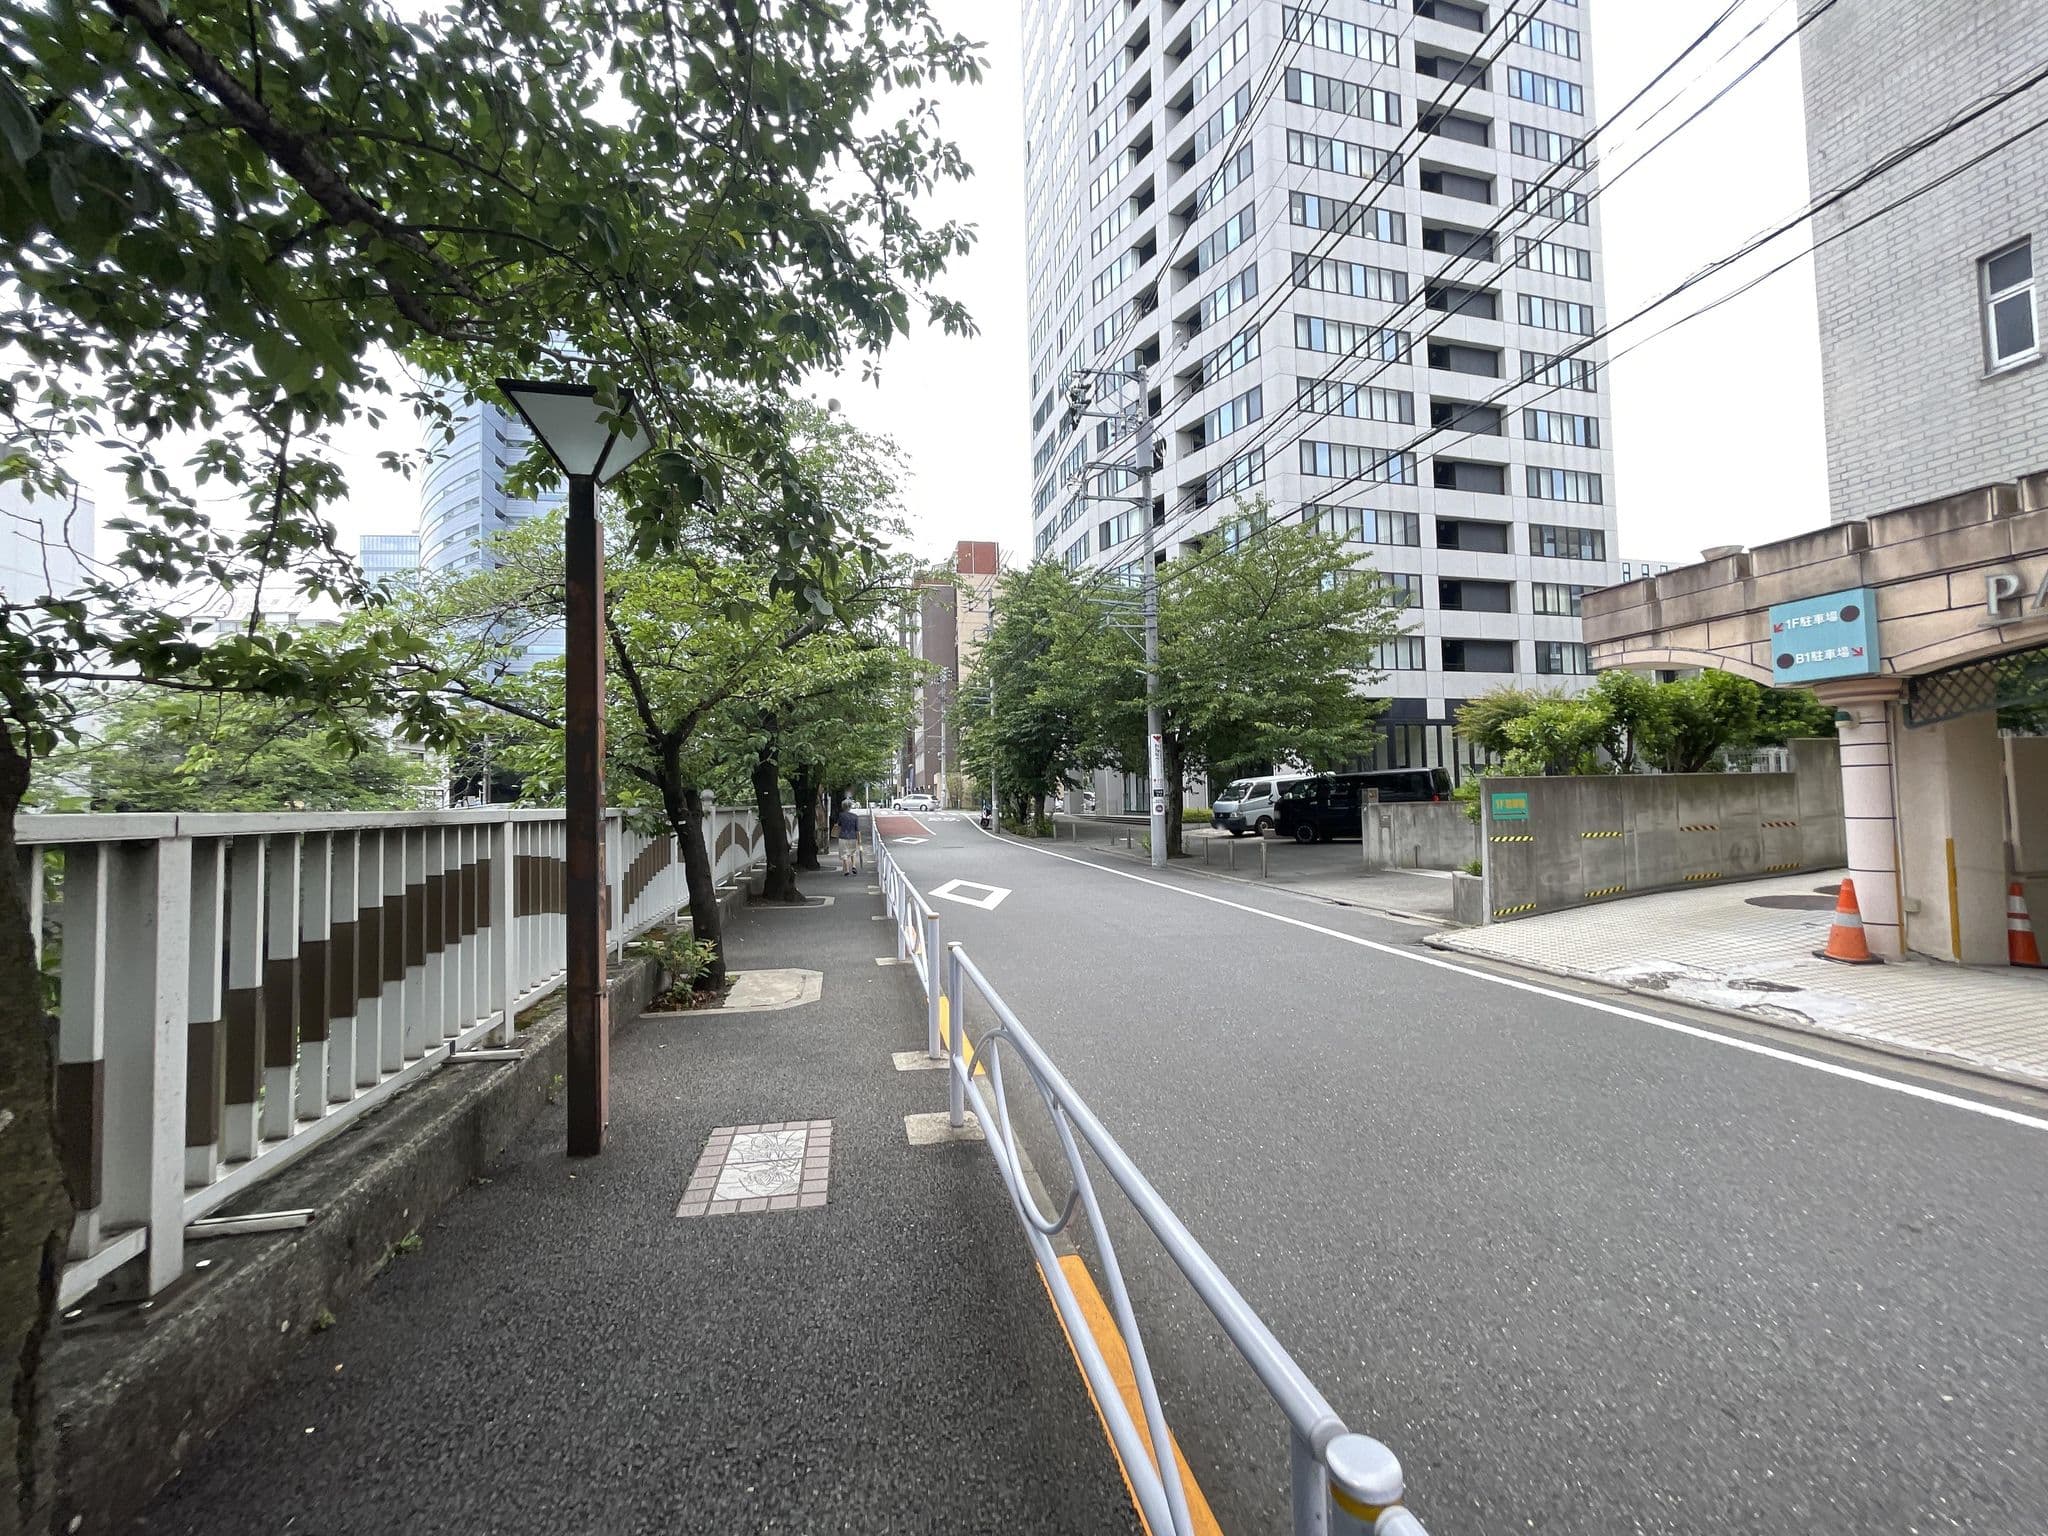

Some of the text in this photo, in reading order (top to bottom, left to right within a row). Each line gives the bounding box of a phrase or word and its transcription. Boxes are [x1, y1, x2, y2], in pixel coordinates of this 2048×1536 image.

[1785, 610, 1838, 629] 1F駐車場
[1795, 646, 1850, 664] B1駐車場
